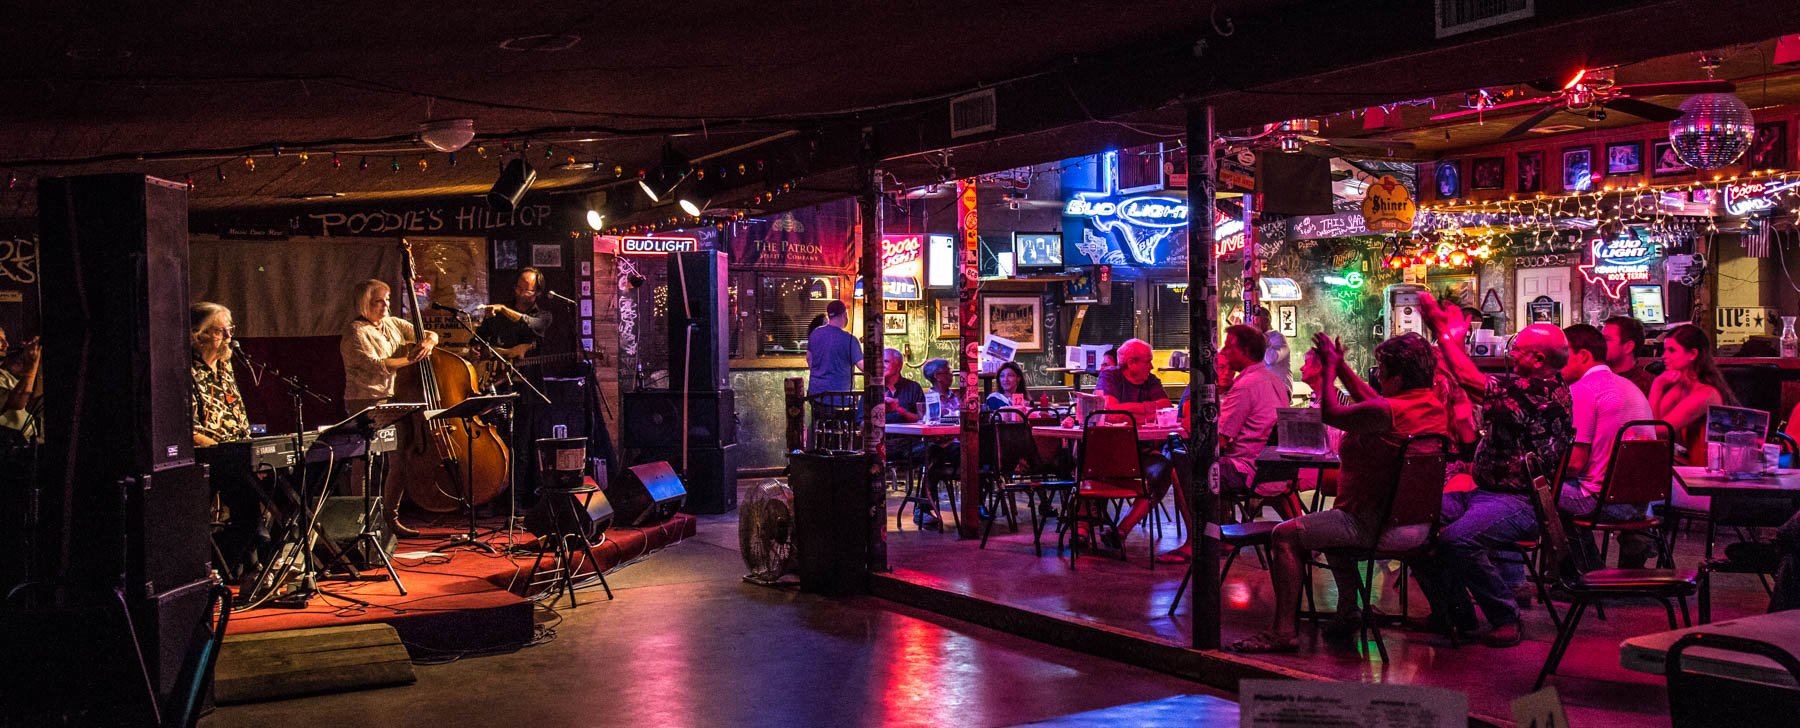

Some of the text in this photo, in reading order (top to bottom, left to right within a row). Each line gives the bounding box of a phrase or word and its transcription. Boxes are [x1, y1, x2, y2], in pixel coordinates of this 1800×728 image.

[1067, 200, 1115, 216] BUD
[1372, 195, 1407, 214] Shiner
[308, 204, 552, 237] POODIE'S HILLTOP
[1319, 217, 1345, 231] THIS
[626, 240, 654, 251] BUD
[655, 240, 693, 252] LIGHT
[754, 240, 777, 252] THE
[1216, 231, 1245, 258] LIVE
[1601, 248, 1647, 257] LIGHT
